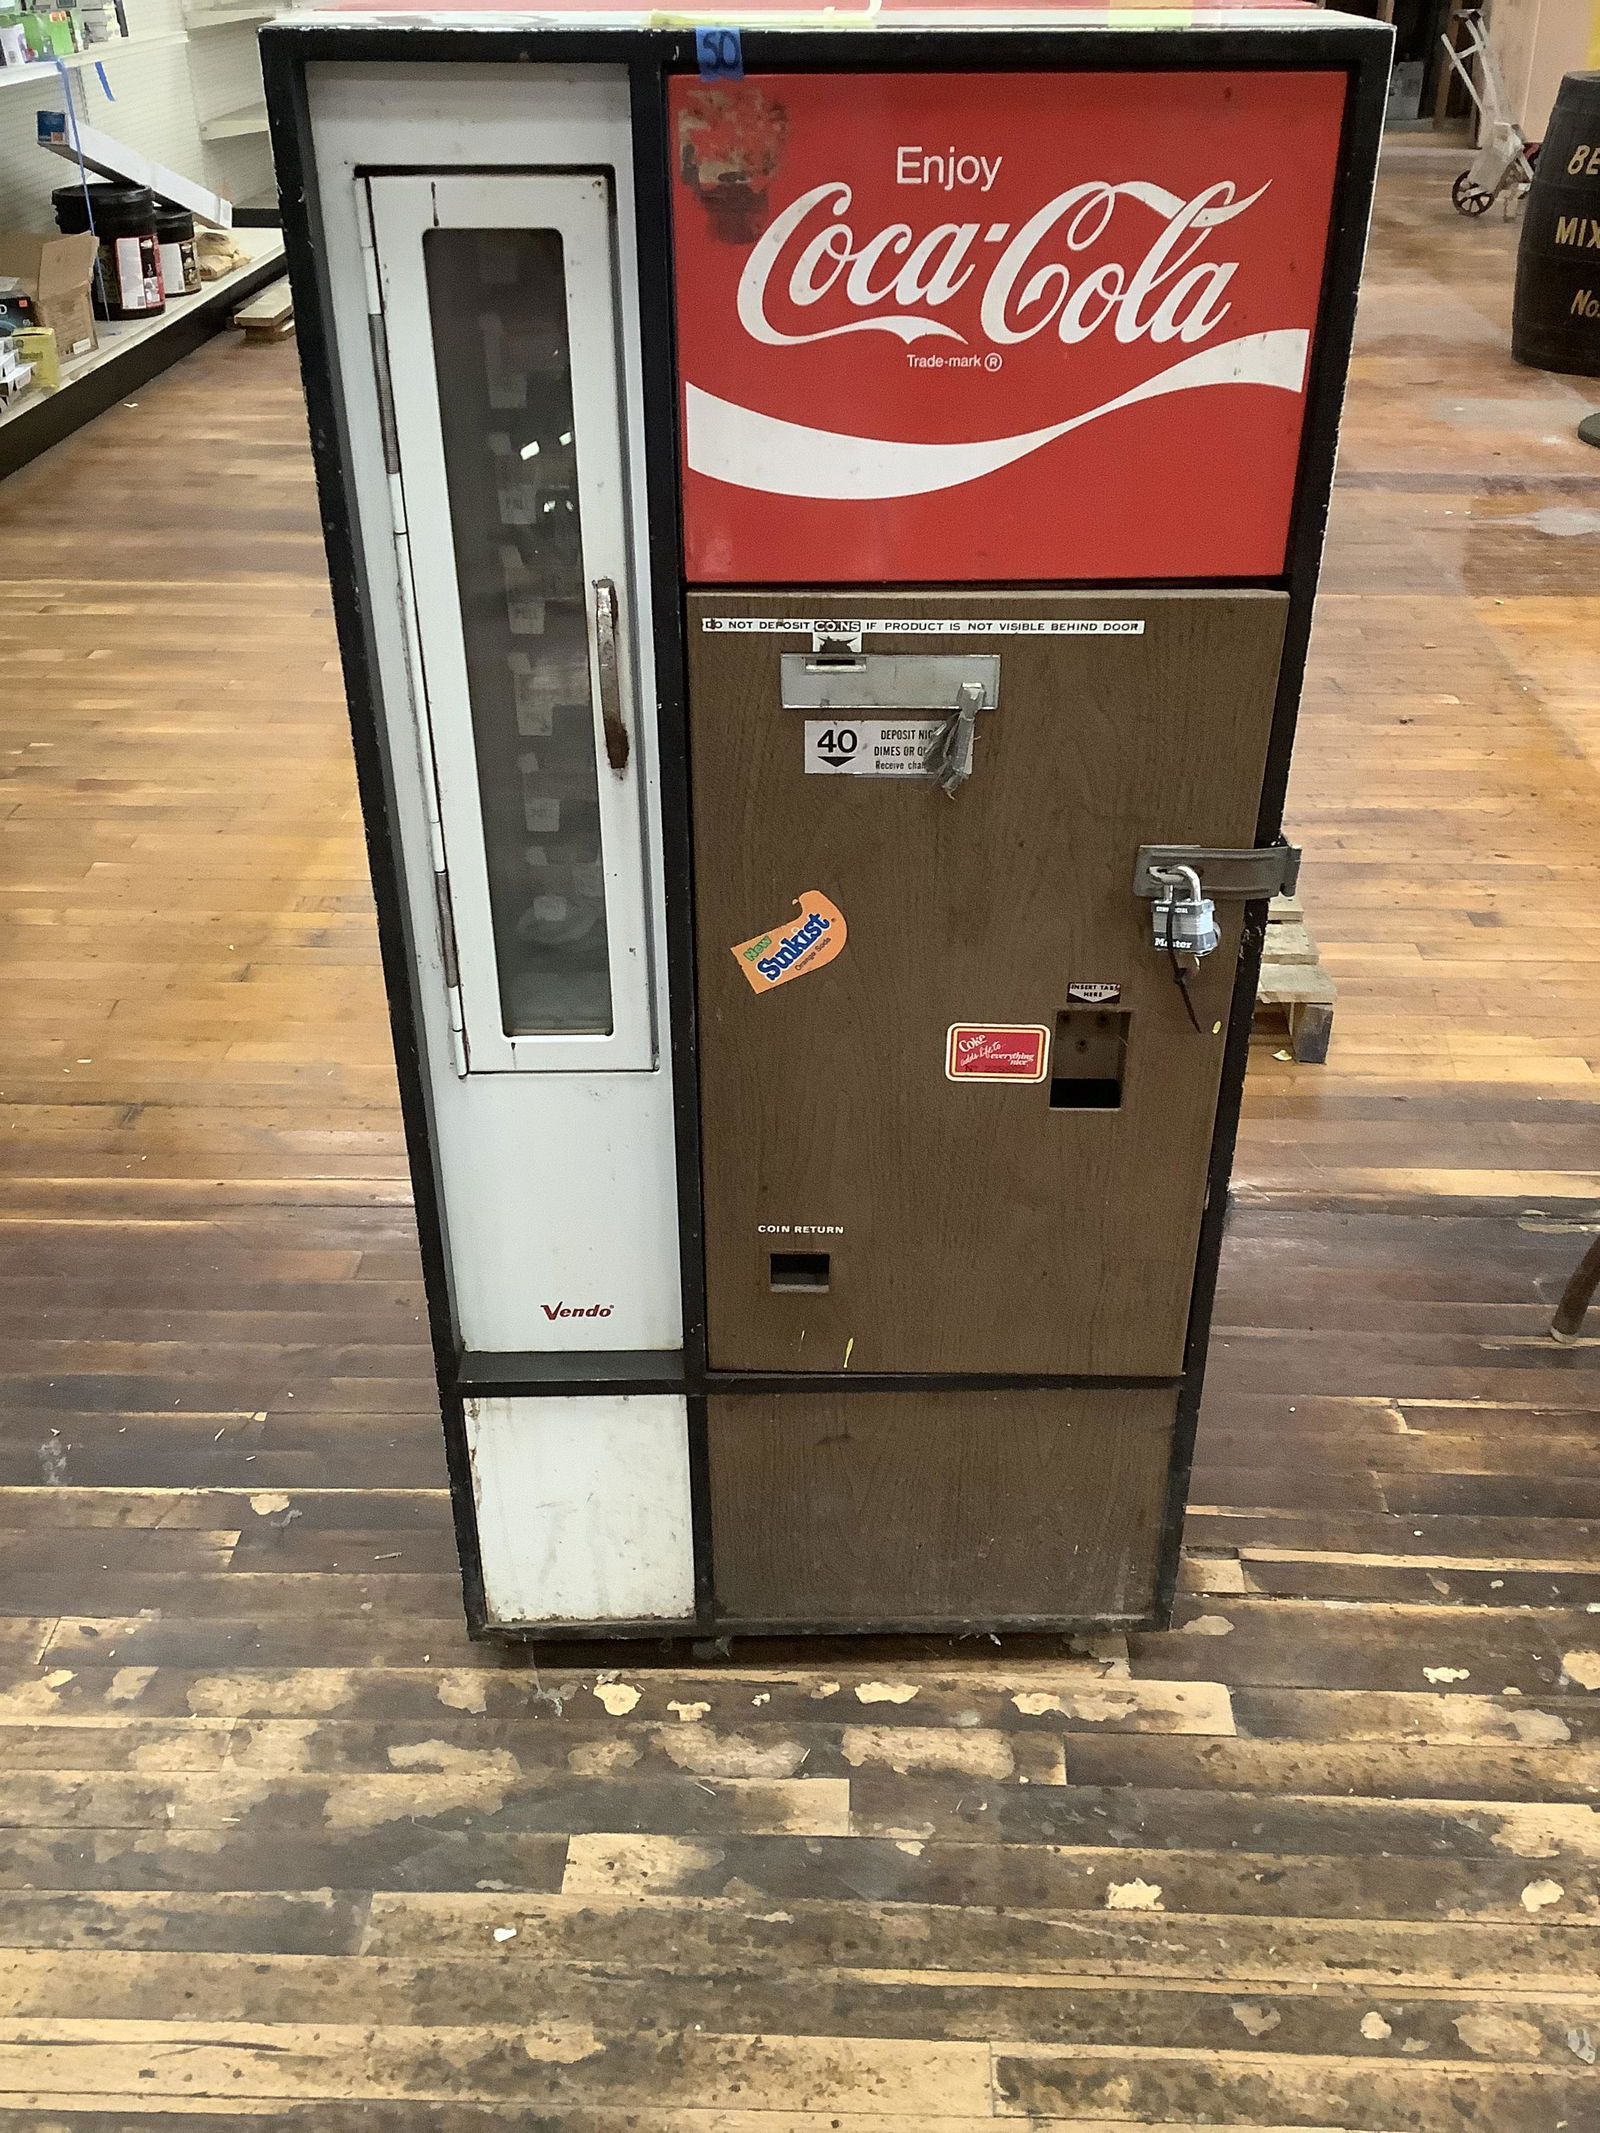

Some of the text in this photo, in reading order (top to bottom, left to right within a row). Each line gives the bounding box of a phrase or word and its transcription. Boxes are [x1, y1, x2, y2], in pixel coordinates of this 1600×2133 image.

[897, 146, 1003, 192] Enjoy
[737, 179, 1273, 346] Coca-Cola
[906, 354, 981, 368] Trade-mark
[705, 621, 723, 630] DO
[728, 621, 753, 630] NOT
[759, 621, 810, 630] DEPOSIT
[866, 622, 877, 631] IF
[884, 622, 944, 631] PRODUCT
[949, 622, 961, 631] IS
[967, 622, 993, 631] NOT
[999, 622, 1045, 631] VISIBLE
[1051, 623, 1098, 631] BEHIND
[1103, 623, 1139, 632] DOOR
[817, 729, 858, 753] 40
[880, 729, 916, 740] DEPOSIT
[874, 746, 901, 756] DIMES
[903, 746, 915, 756] OR
[875, 760, 905, 770] Receive
[743, 935, 772, 962] New
[757, 913, 830, 981] Sunkist
[795, 936, 831, 971] Orange Soda
[958, 1034, 987, 1052] Coke
[990, 1051, 1035, 1063] everything
[758, 1225, 844, 1234] COIN RETURN
[540, 1301, 612, 1320] Vendo
